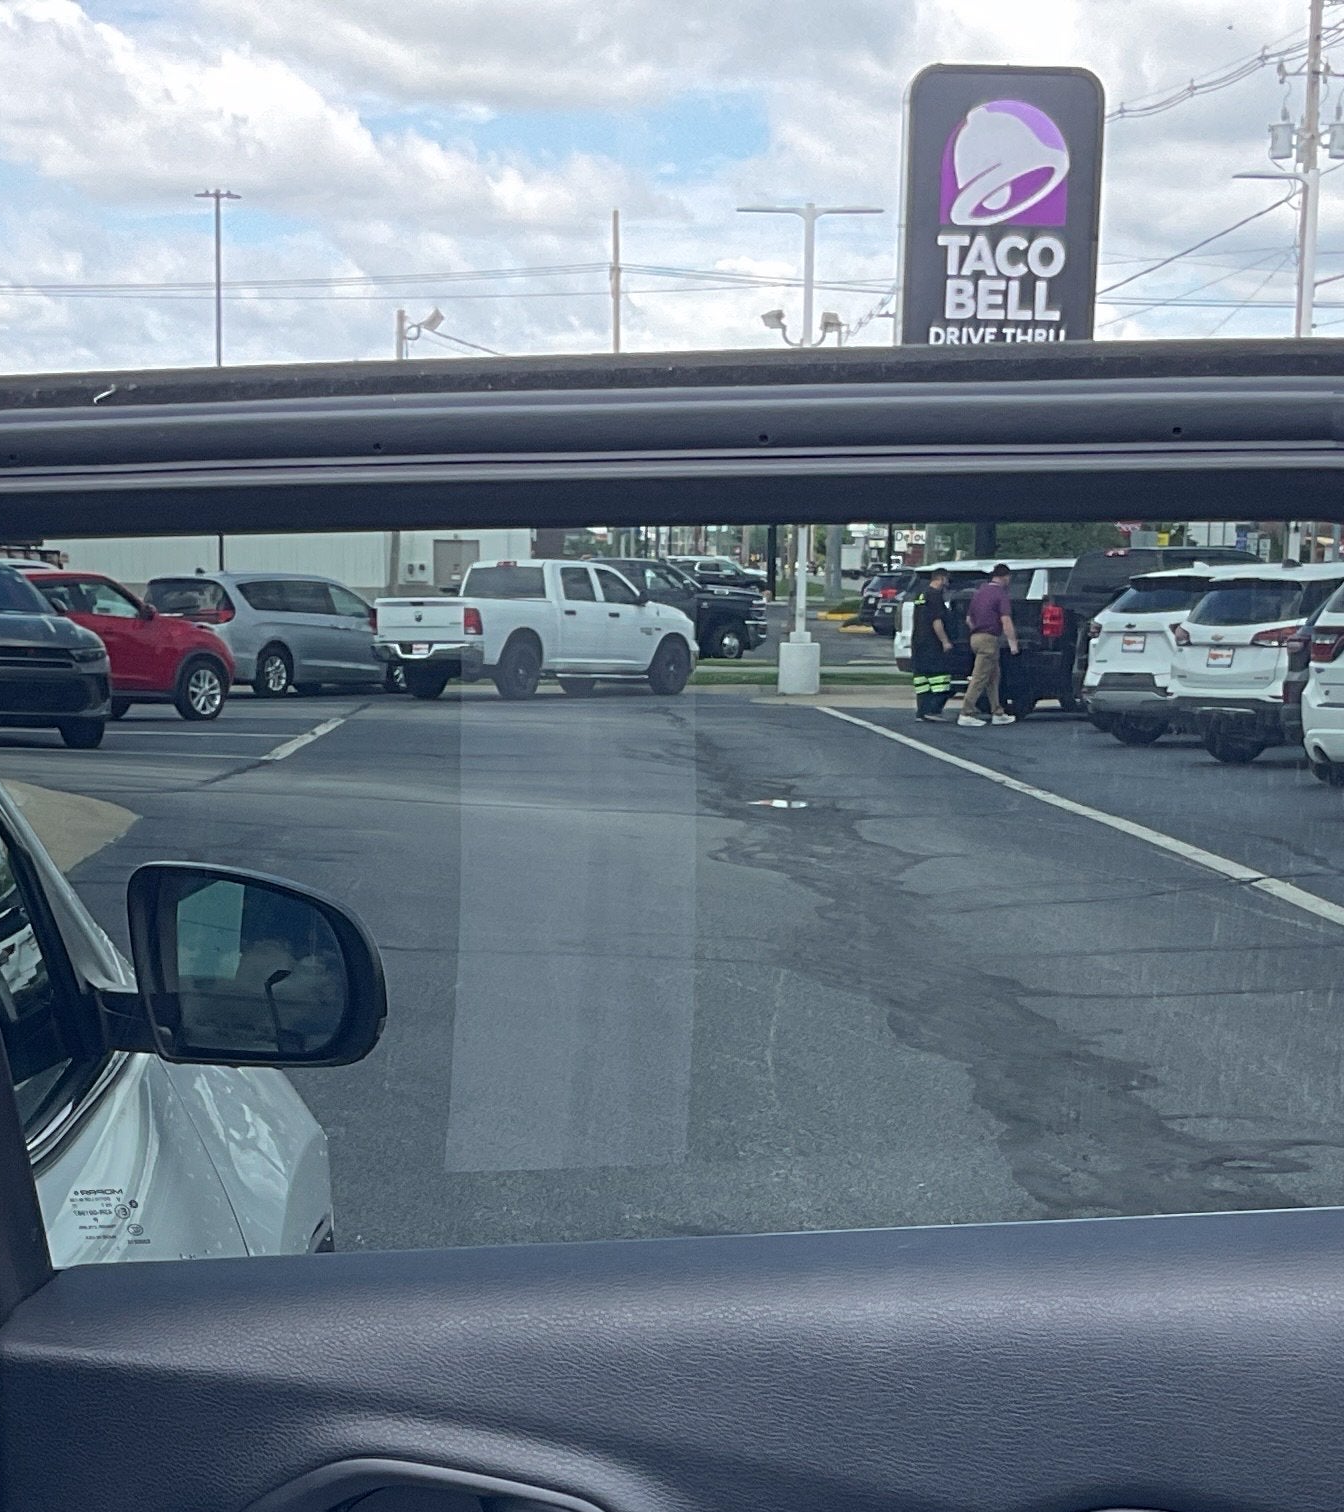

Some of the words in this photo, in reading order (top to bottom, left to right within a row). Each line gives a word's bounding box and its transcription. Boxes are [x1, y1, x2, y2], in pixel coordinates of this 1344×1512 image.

[937, 234, 1066, 278] TACO
[945, 278, 1061, 321] BELL
[929, 327, 996, 345] DRIVE
